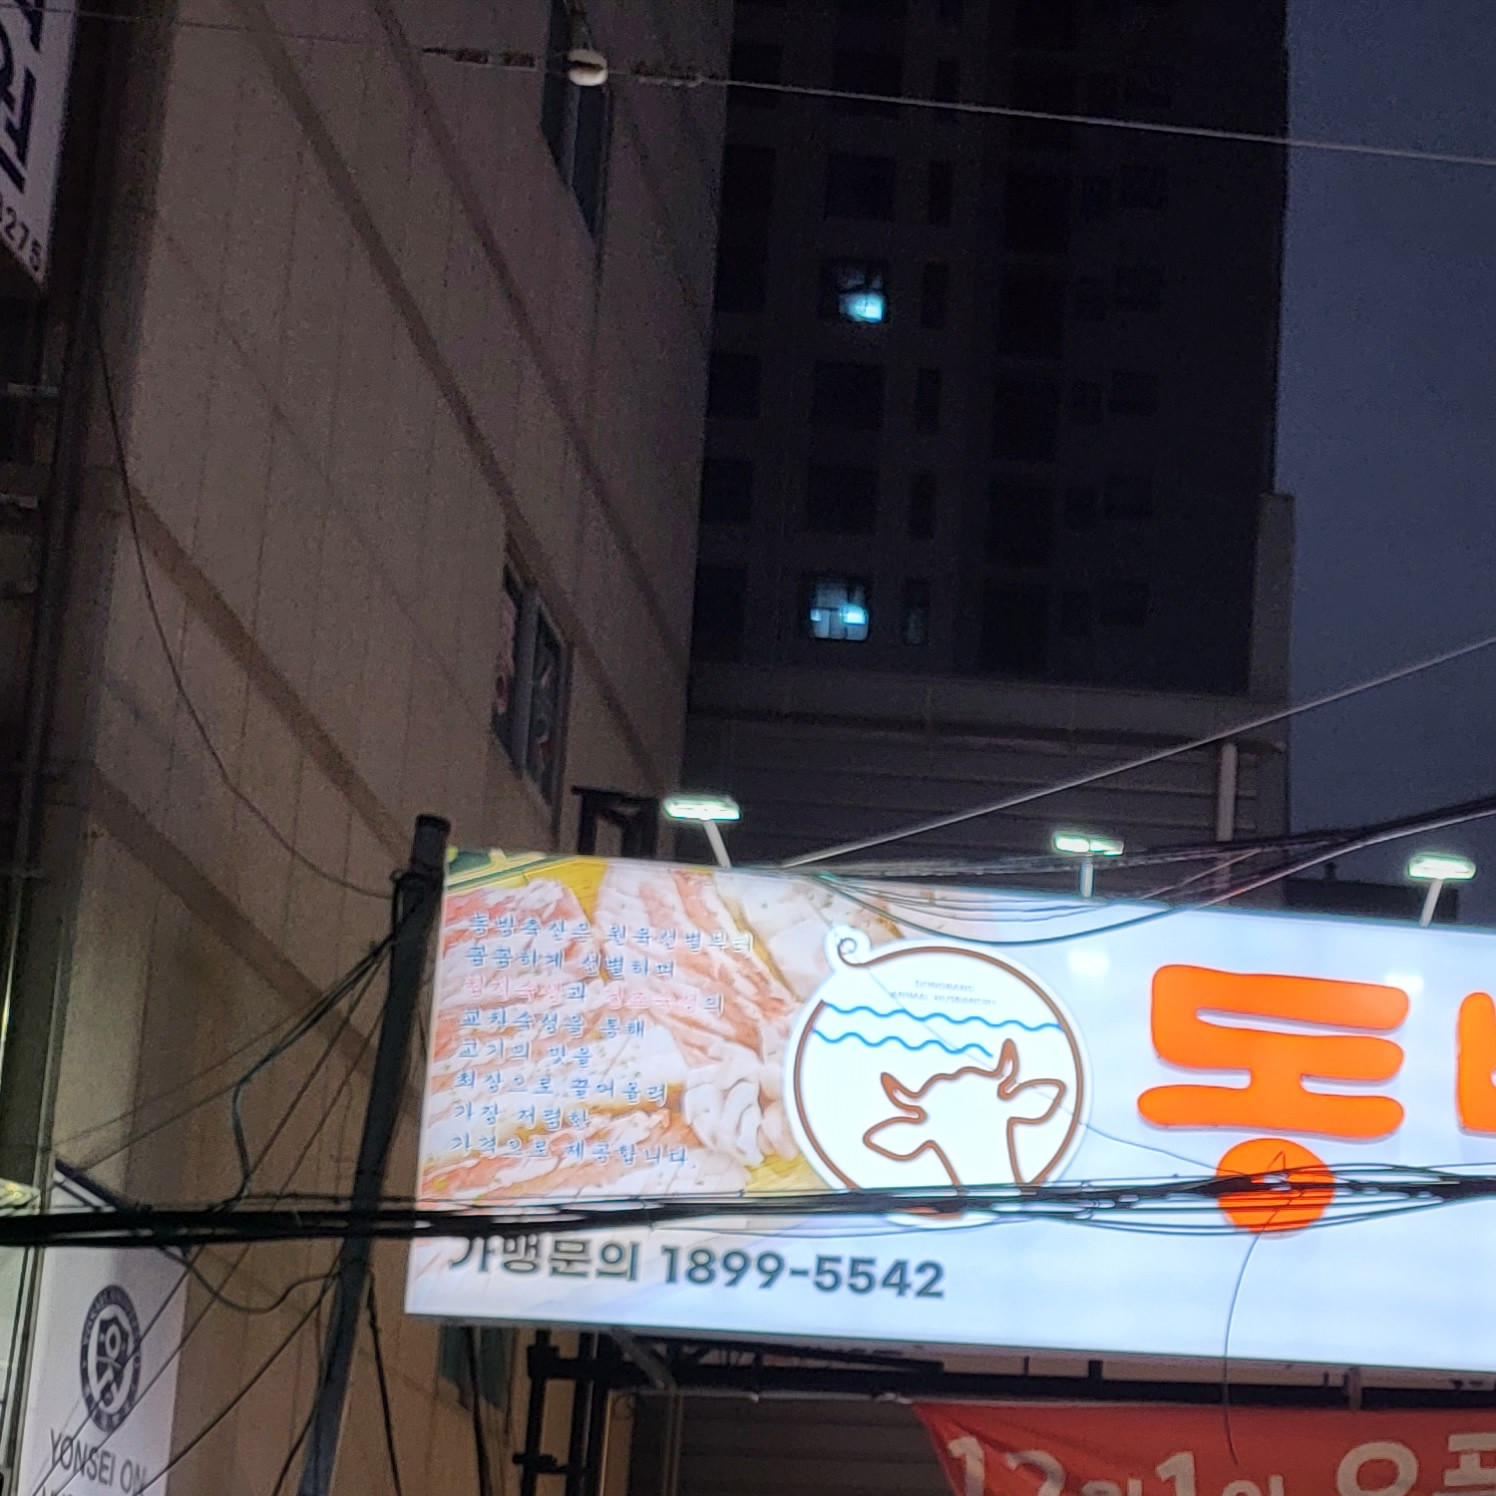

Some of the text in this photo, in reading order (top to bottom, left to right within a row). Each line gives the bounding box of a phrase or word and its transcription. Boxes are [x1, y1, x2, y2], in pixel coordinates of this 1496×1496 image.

[454, 1102, 499, 1125] 가장
[450, 1133, 549, 1158] 가격으로
[448, 1234, 946, 1300] 가맹문의 1899-5542
[51, 1428, 117, 1487] YONSEI
